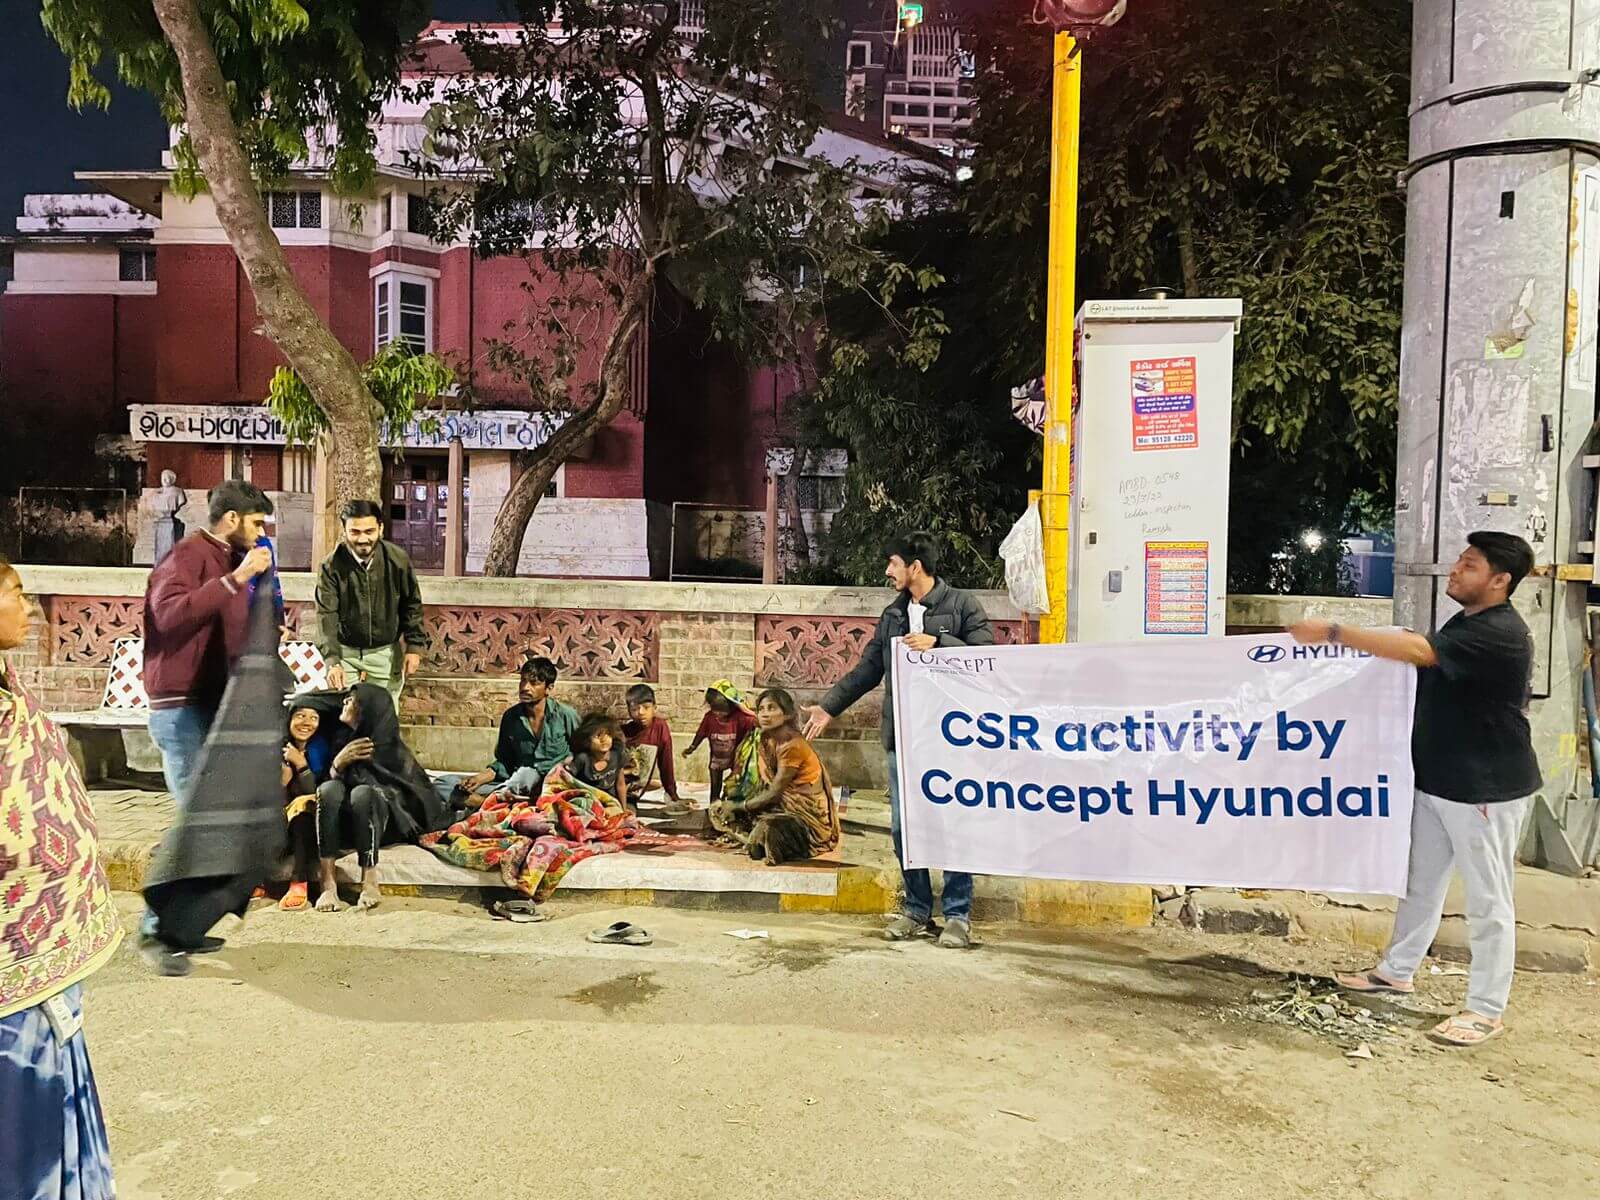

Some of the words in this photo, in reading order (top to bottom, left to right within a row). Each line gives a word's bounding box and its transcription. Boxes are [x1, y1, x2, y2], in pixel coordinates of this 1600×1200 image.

[940, 710, 1041, 752] CSR
[1054, 710, 1262, 762] activity
[1276, 710, 1345, 760] by
[921, 769, 1133, 823] Concept
[1147, 774, 1390, 825] Hyundai
